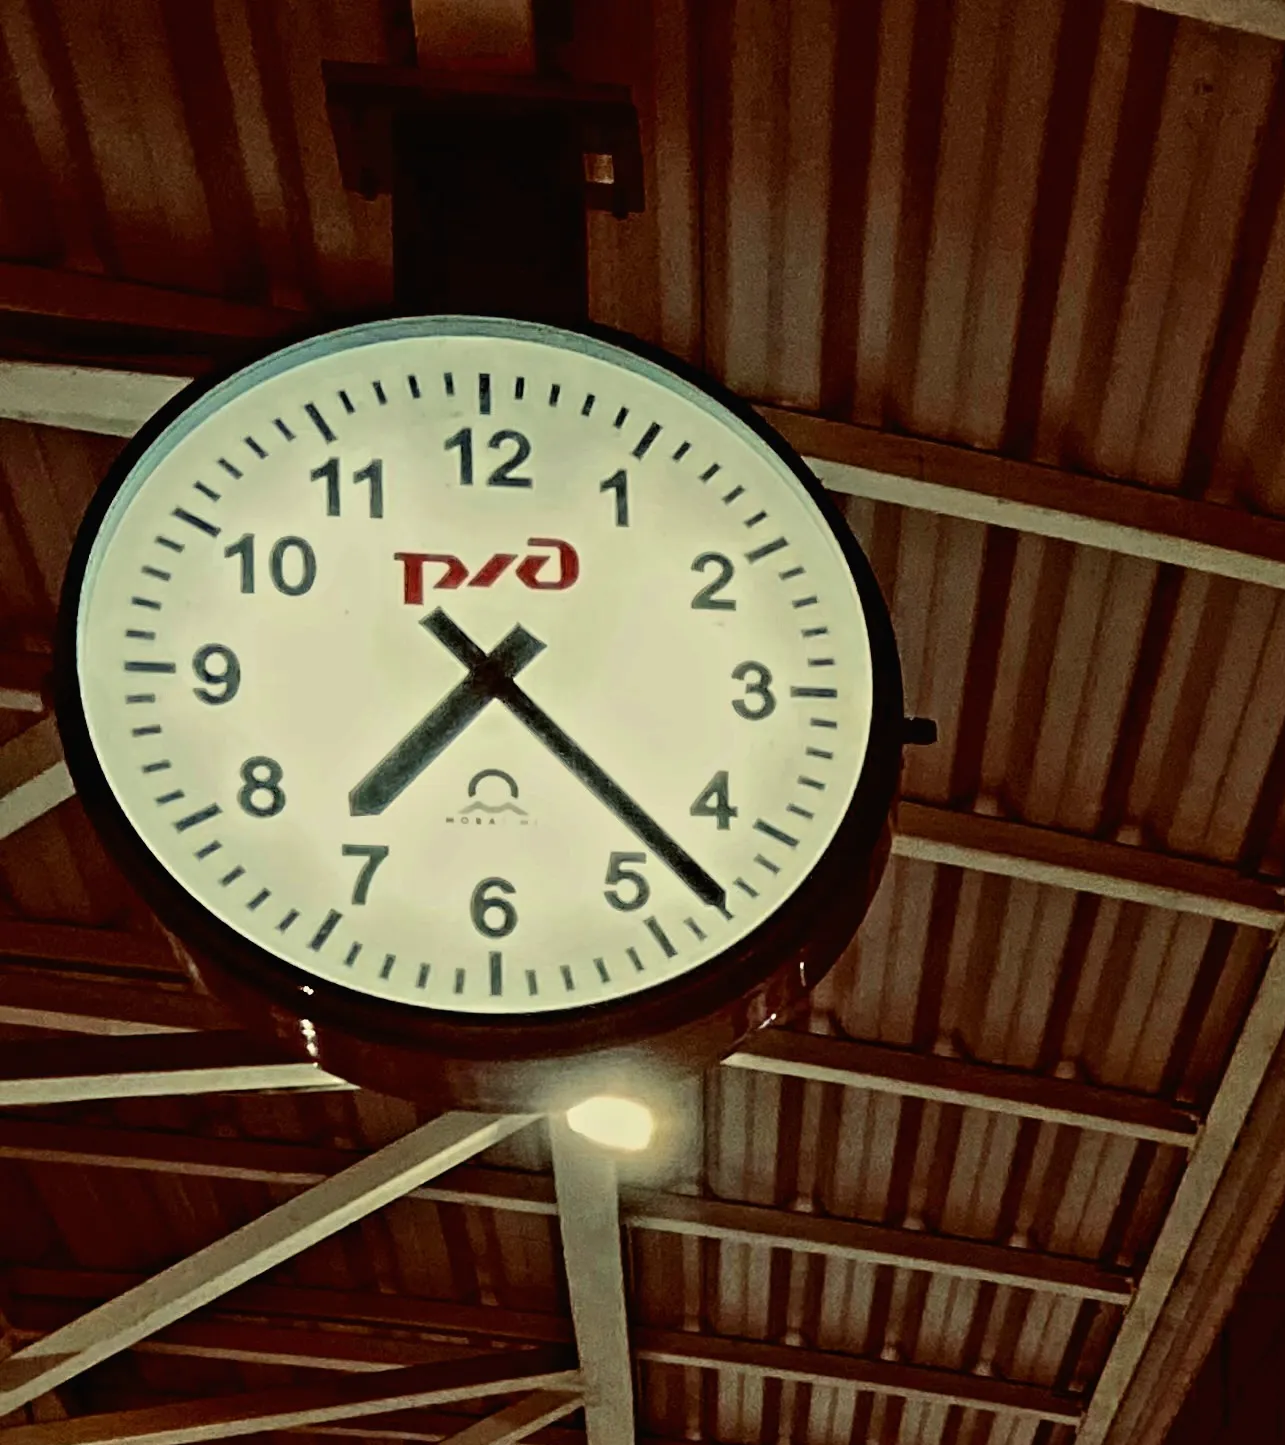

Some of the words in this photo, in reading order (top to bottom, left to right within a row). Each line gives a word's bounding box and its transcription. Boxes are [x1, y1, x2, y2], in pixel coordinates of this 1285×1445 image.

[444, 427, 532, 488] 12
[311, 458, 383, 519] 11
[600, 469, 629, 527] 1
[225, 534, 316, 596] 10
[691, 552, 736, 611] 2
[193, 644, 240, 705] 9
[731, 661, 776, 720] 3
[238, 756, 285, 818] 8
[690, 771, 737, 830] 4
[342, 844, 389, 905] 7
[604, 852, 650, 912] 5
[471, 877, 517, 938] 6
